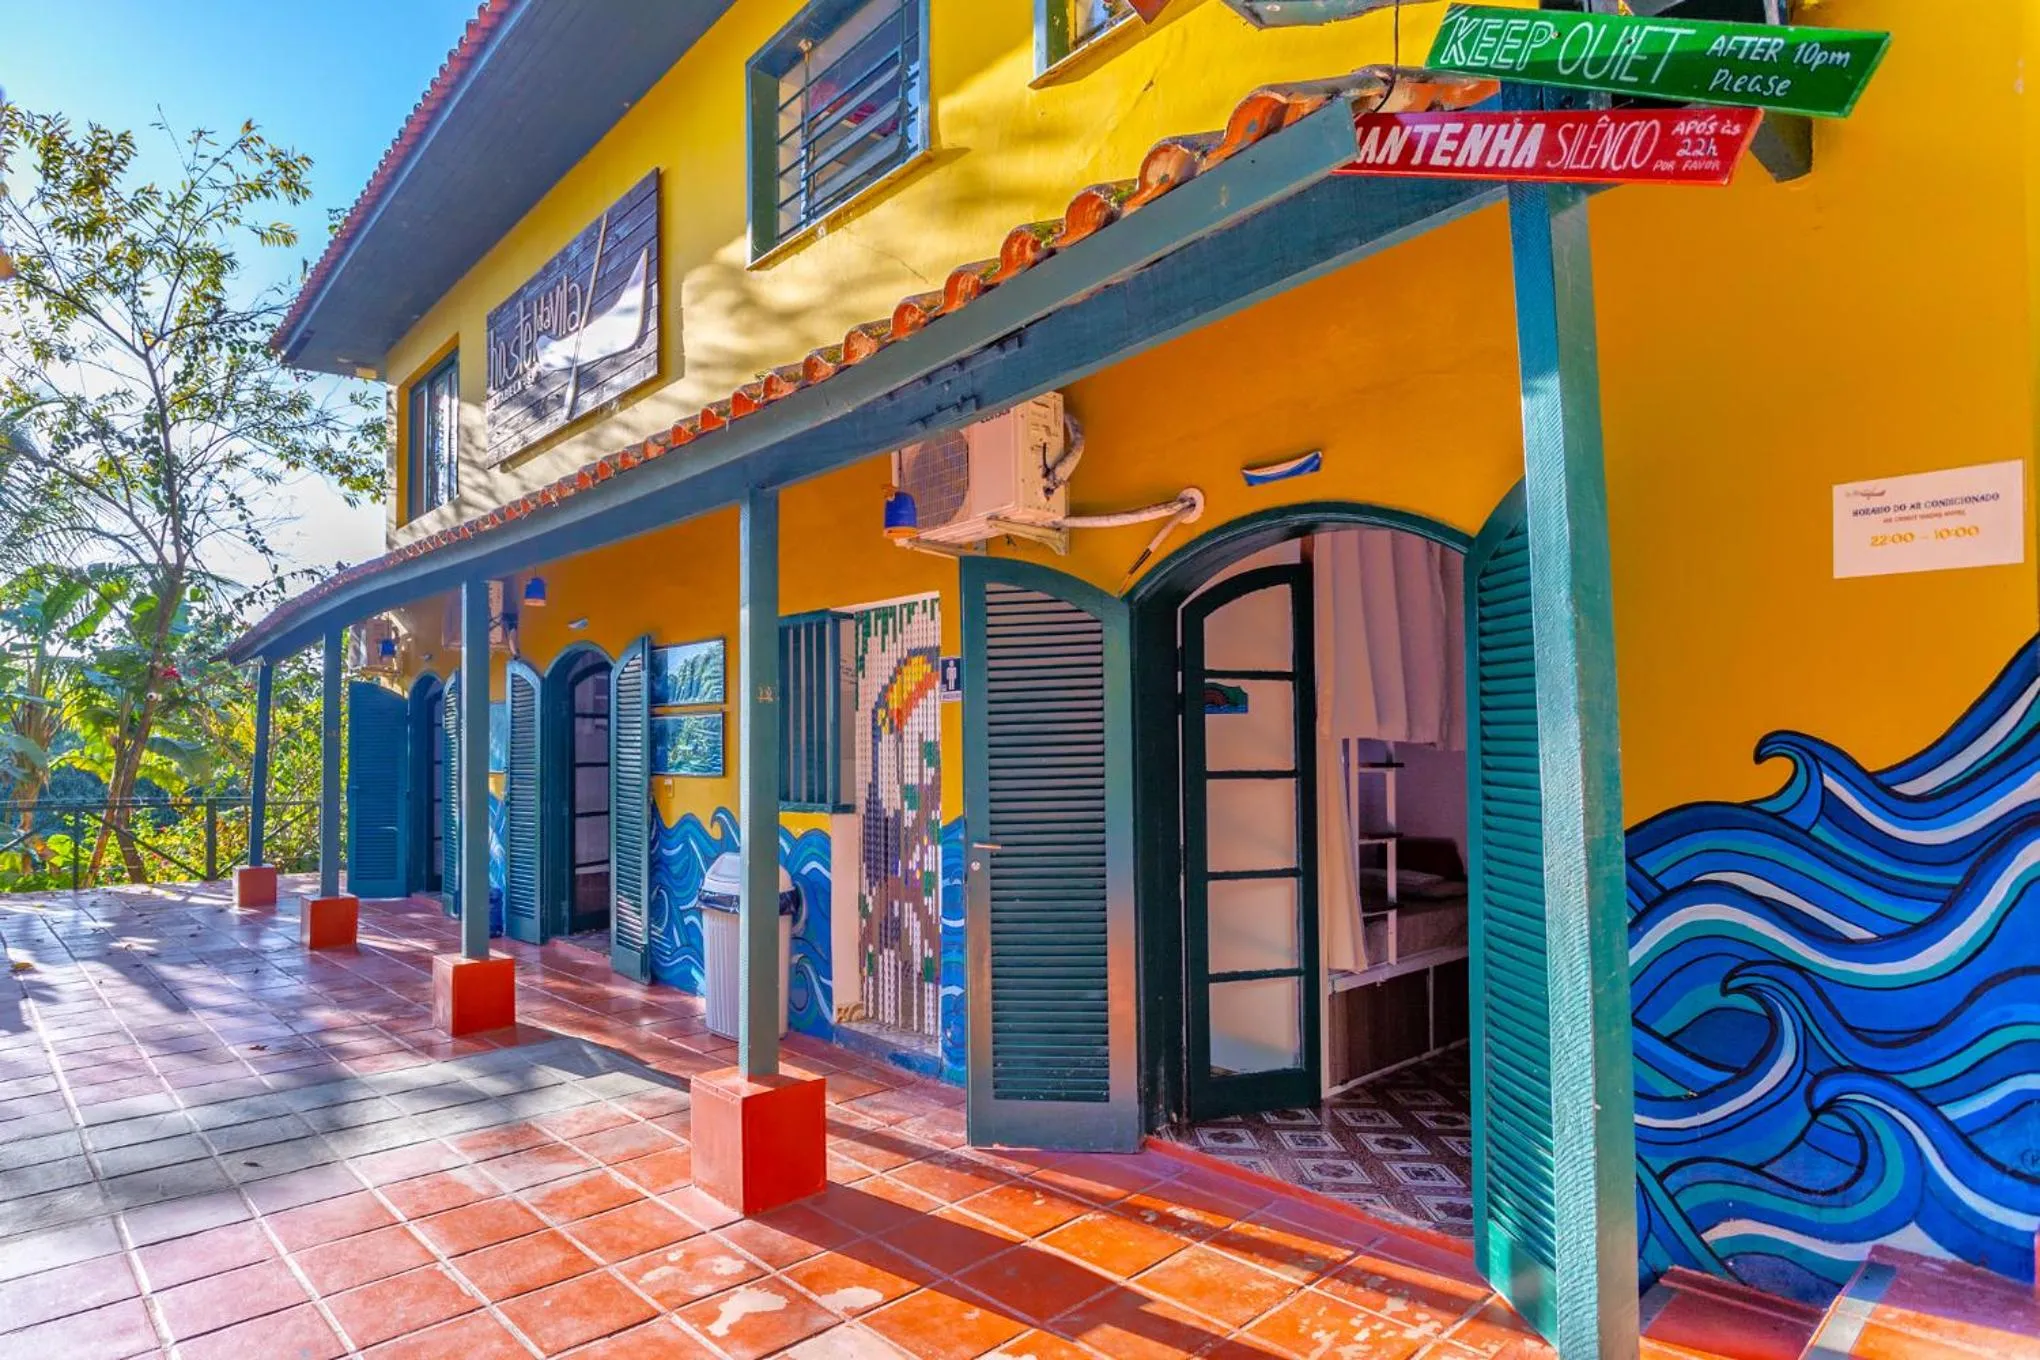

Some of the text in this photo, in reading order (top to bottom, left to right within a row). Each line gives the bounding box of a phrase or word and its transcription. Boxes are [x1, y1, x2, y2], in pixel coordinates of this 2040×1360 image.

[1440, 16, 1553, 71] KEEP
[1706, 34, 1850, 72] AFTER 10pm
[1546, 114, 1660, 171] SILÊNCIO
[1676, 138, 1718, 157] 22h
[1653, 159, 1675, 173] POR
